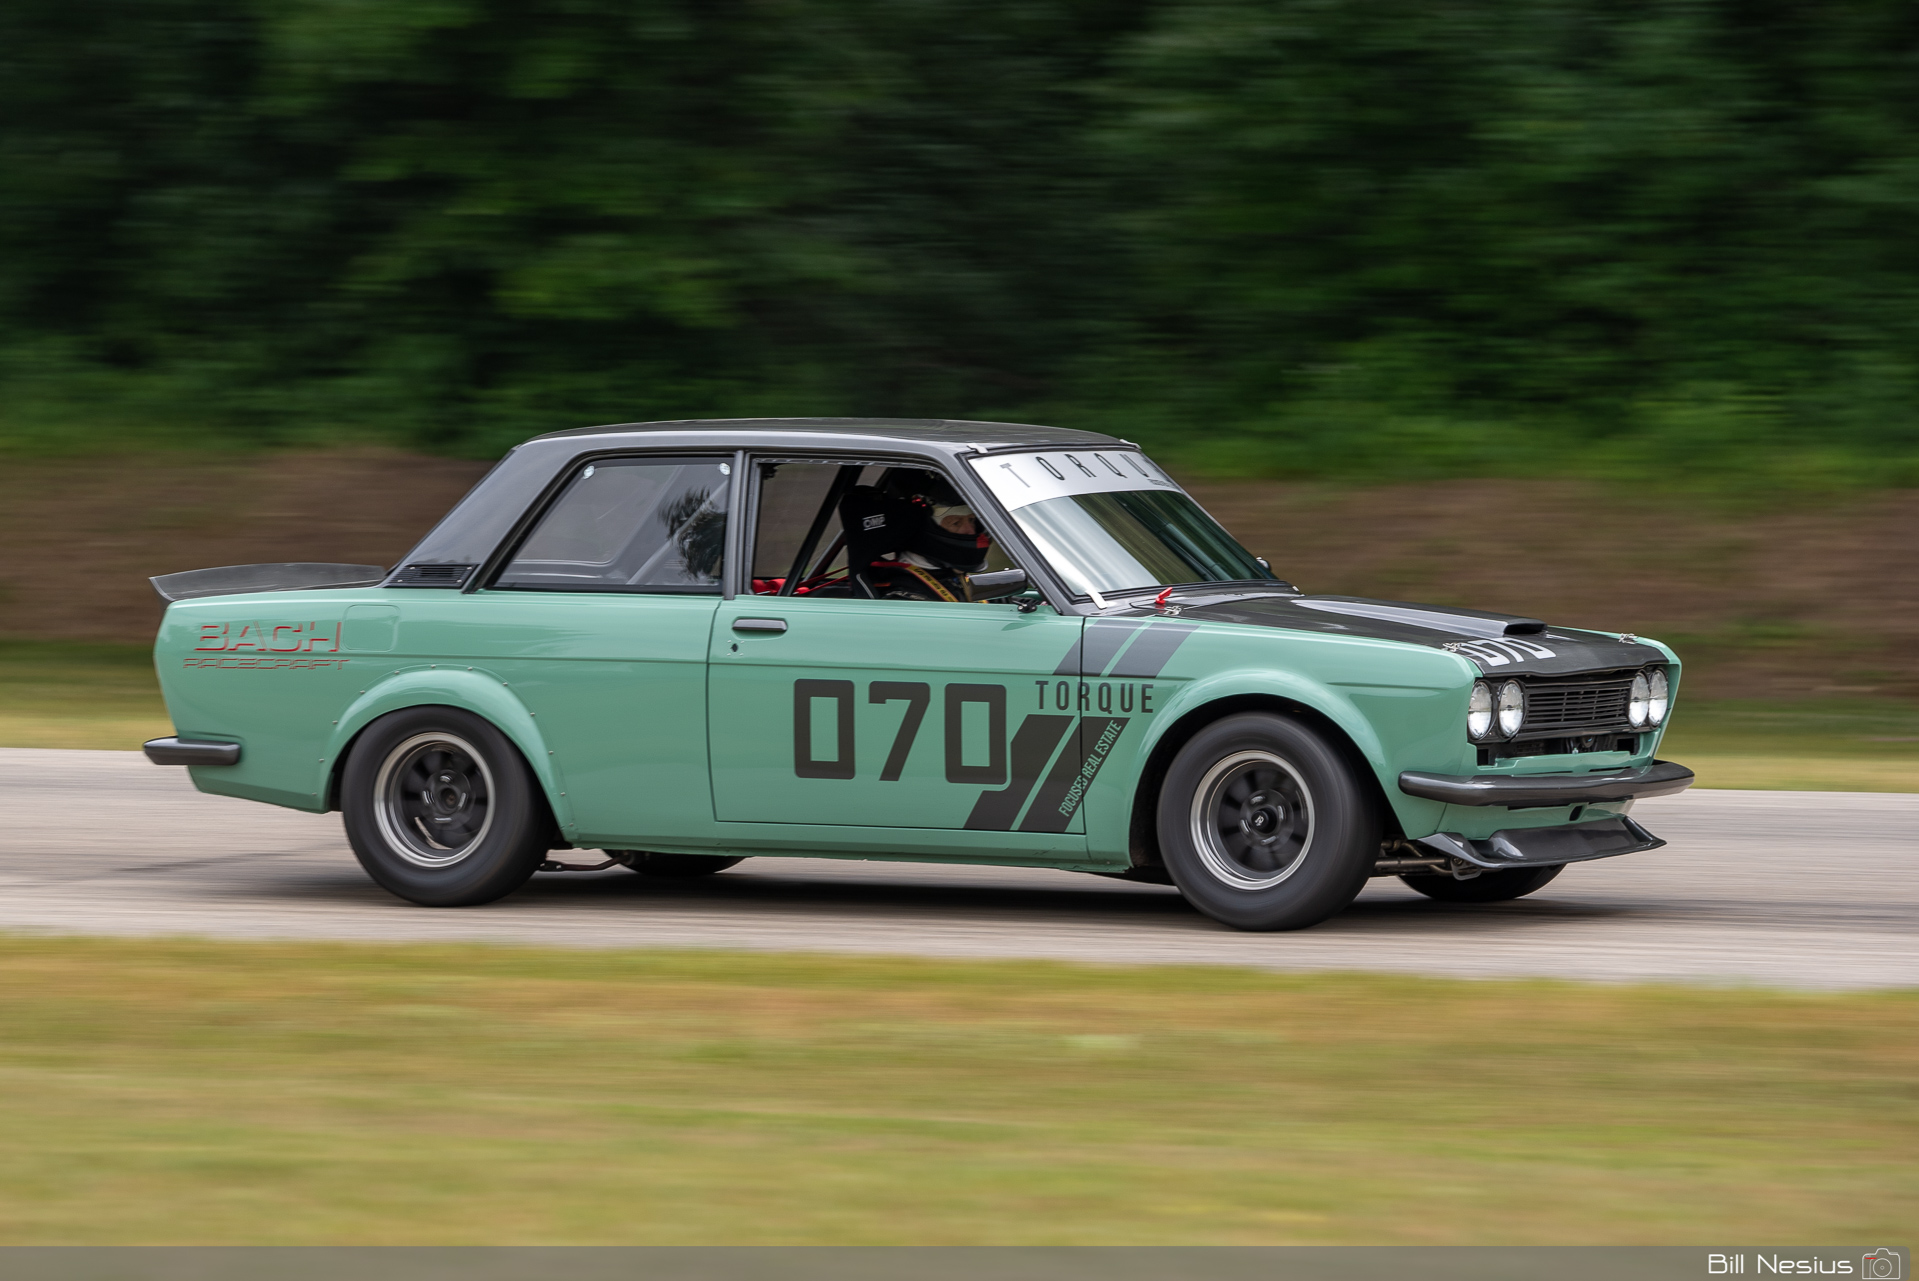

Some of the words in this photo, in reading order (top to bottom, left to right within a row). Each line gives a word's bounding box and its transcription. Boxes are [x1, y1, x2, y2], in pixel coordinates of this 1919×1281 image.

[1000, 452, 1173, 488] TORQU
[194, 621, 342, 652] BACH
[1459, 637, 1556, 667] 070
[1035, 680, 1154, 714] TORQUE
[794, 678, 1007, 785] 070
[1082, 754, 1103, 779] REAL
[1094, 719, 1122, 756] ESTATE
